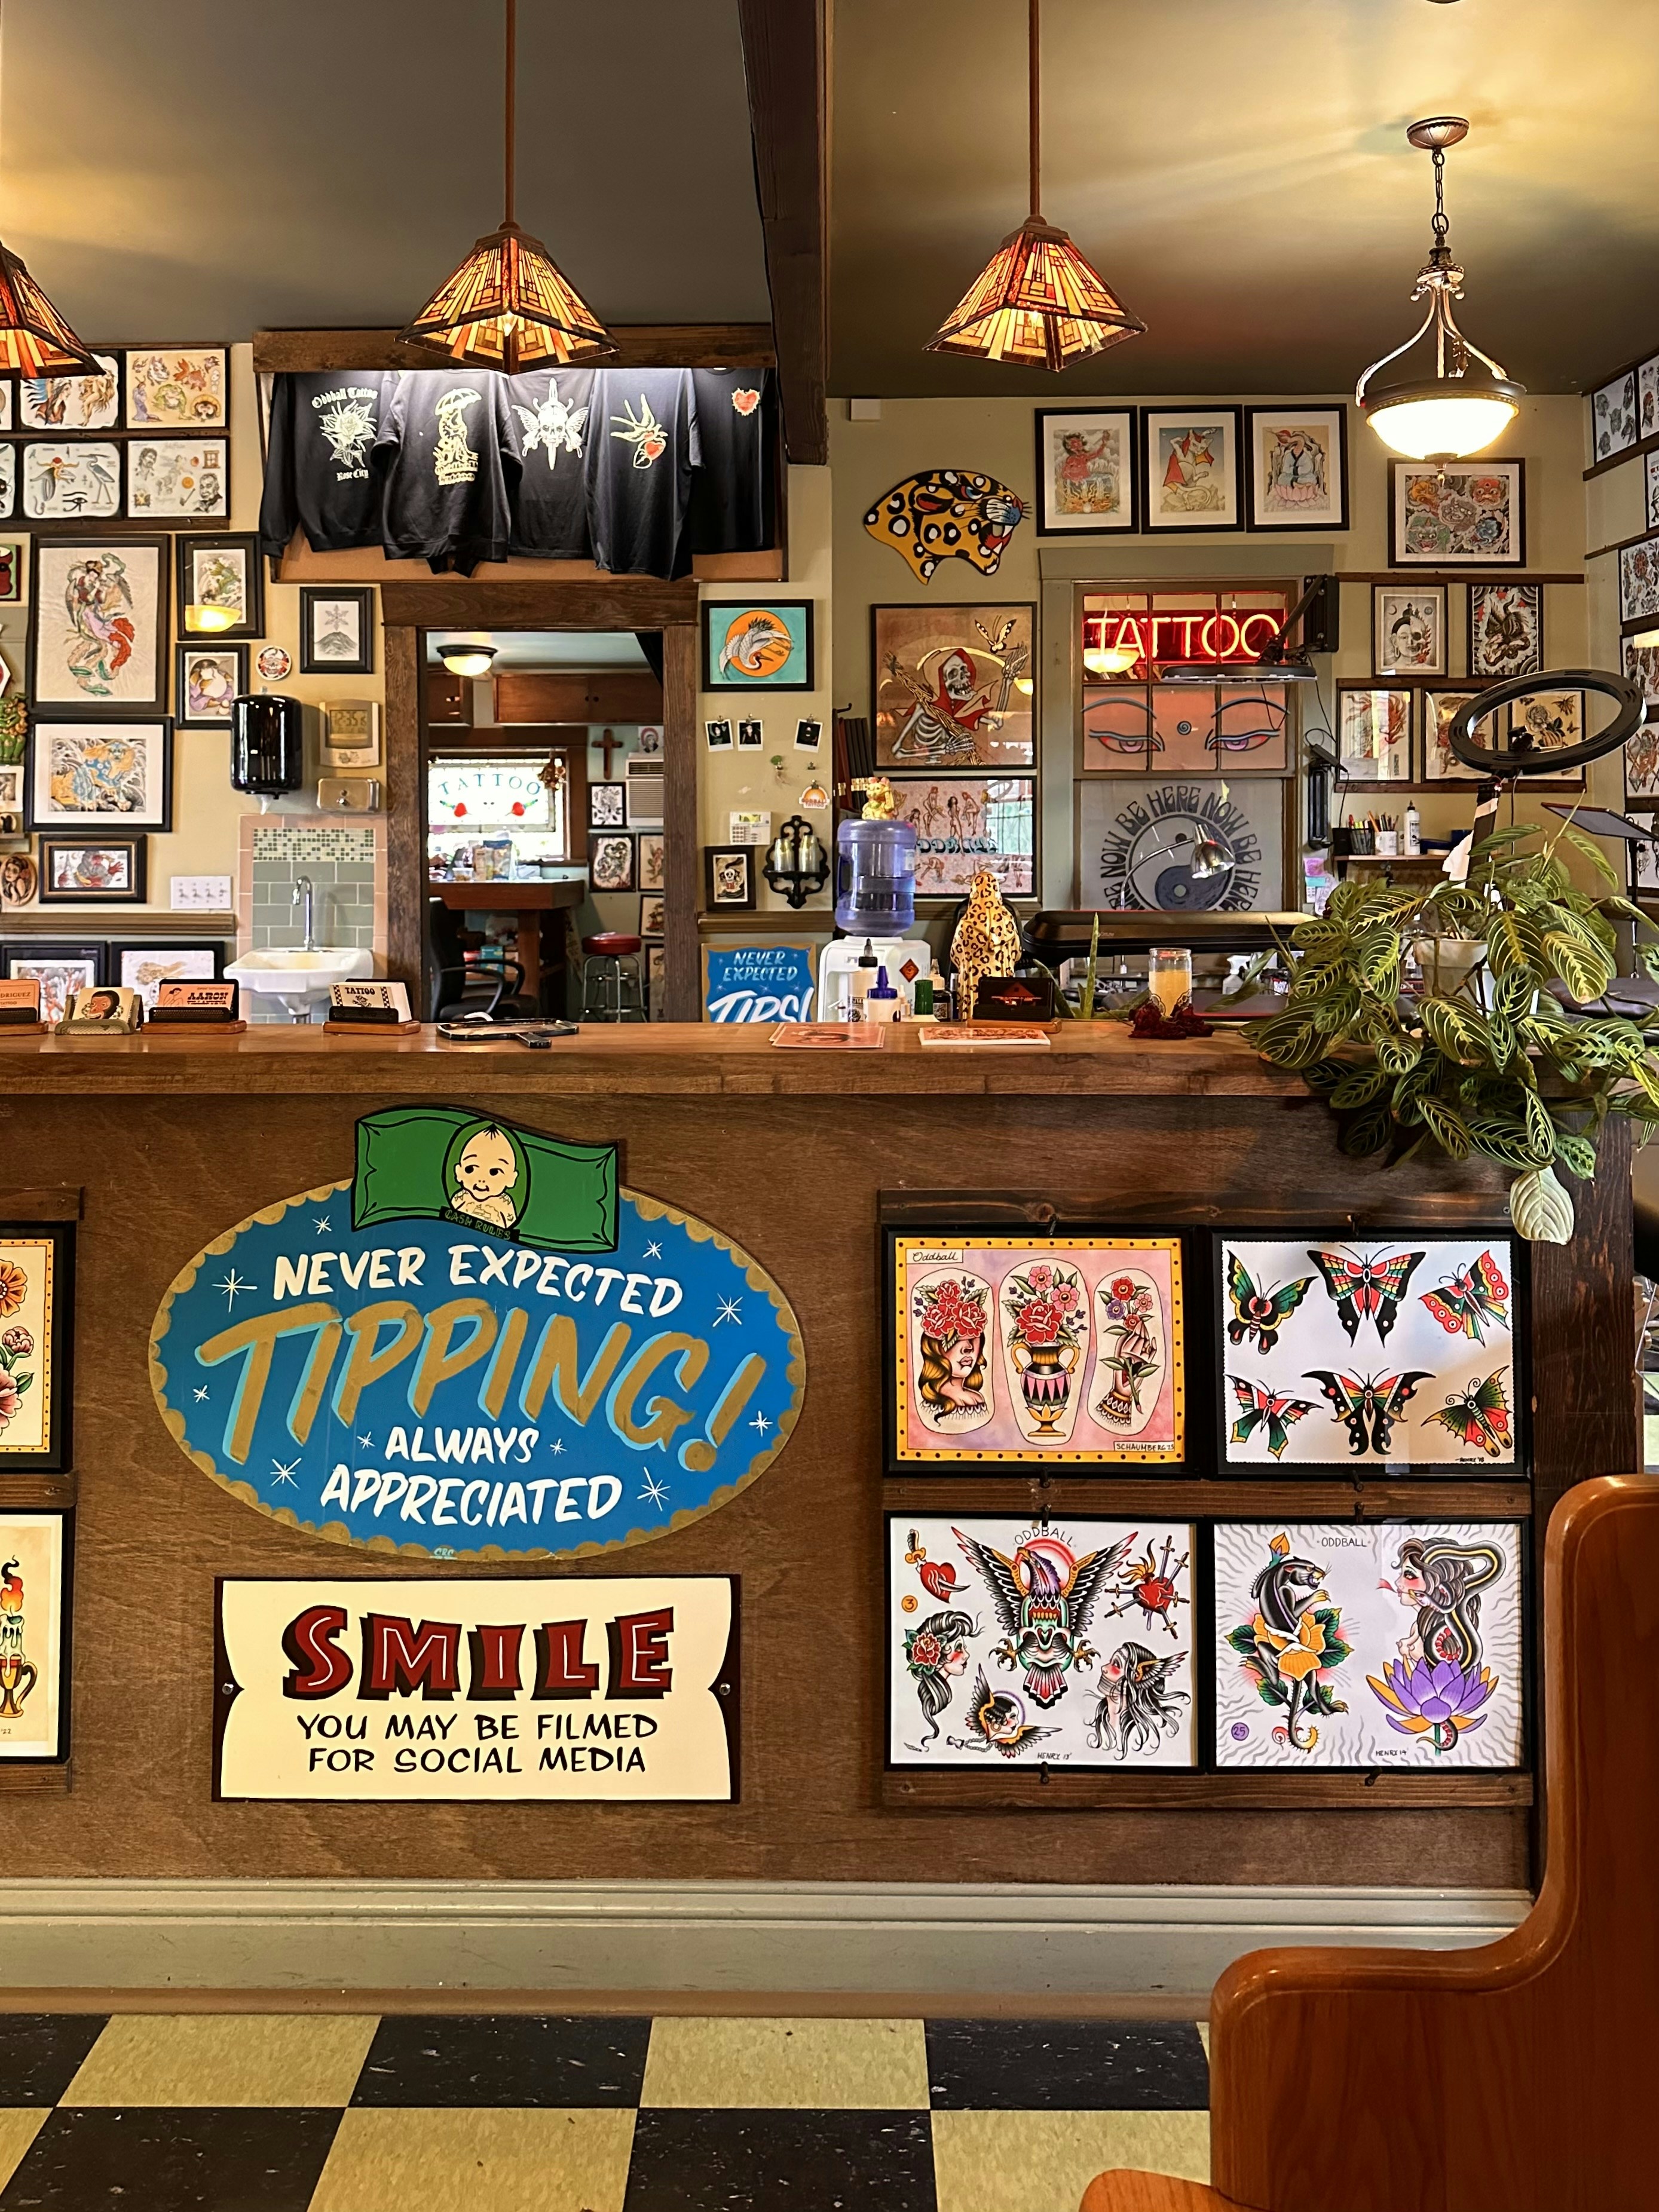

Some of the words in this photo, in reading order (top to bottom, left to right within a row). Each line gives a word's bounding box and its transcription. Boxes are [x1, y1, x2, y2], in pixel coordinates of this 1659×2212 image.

[311, 388, 347, 409] Oddball
[1087, 614, 1281, 658] TATTOO
[438, 773, 541, 795] TATTOO
[1146, 786, 1201, 818] HERE
[1200, 792, 1249, 838] NOW
[1115, 801, 1151, 837] BE
[1101, 831, 1132, 878] NOW
[1231, 834, 1262, 864] BE
[733, 950, 786, 966] NEVER
[723, 966, 798, 982] EXPECTED
[187, 992, 228, 1000] AARON
[344, 986, 376, 995] TATTOO
[445, 1209, 473, 1227] CASH
[475, 1220, 511, 1240] RULES
[912, 1251, 959, 1262] Oddball
[273, 1247, 426, 1300] NEVER
[448, 1243, 683, 1318] EXPECTED
[195, 1298, 767, 1473] TIPPING!
[384, 1426, 540, 1465] ALWAYS
[320, 1463, 623, 1527] APPRECIATED
[1014, 1526, 1073, 1548] ODDBALL
[1321, 1537, 1367, 1548] ODDBALL
[905, 1598, 914, 1610] 3
[281, 1605, 675, 1701] SMILE
[296, 1713, 368, 1739] YOU
[385, 1713, 458, 1740] MAY
[474, 1714, 519, 1741] BE
[537, 1713, 658, 1740] FILMED
[1233, 1726, 1246, 1737] 25
[309, 1748, 375, 1772] FOR
[394, 1747, 523, 1773] SOCIAL
[538, 1746, 645, 1773] MEDIA
[1037, 1752, 1061, 1760] HENRY
